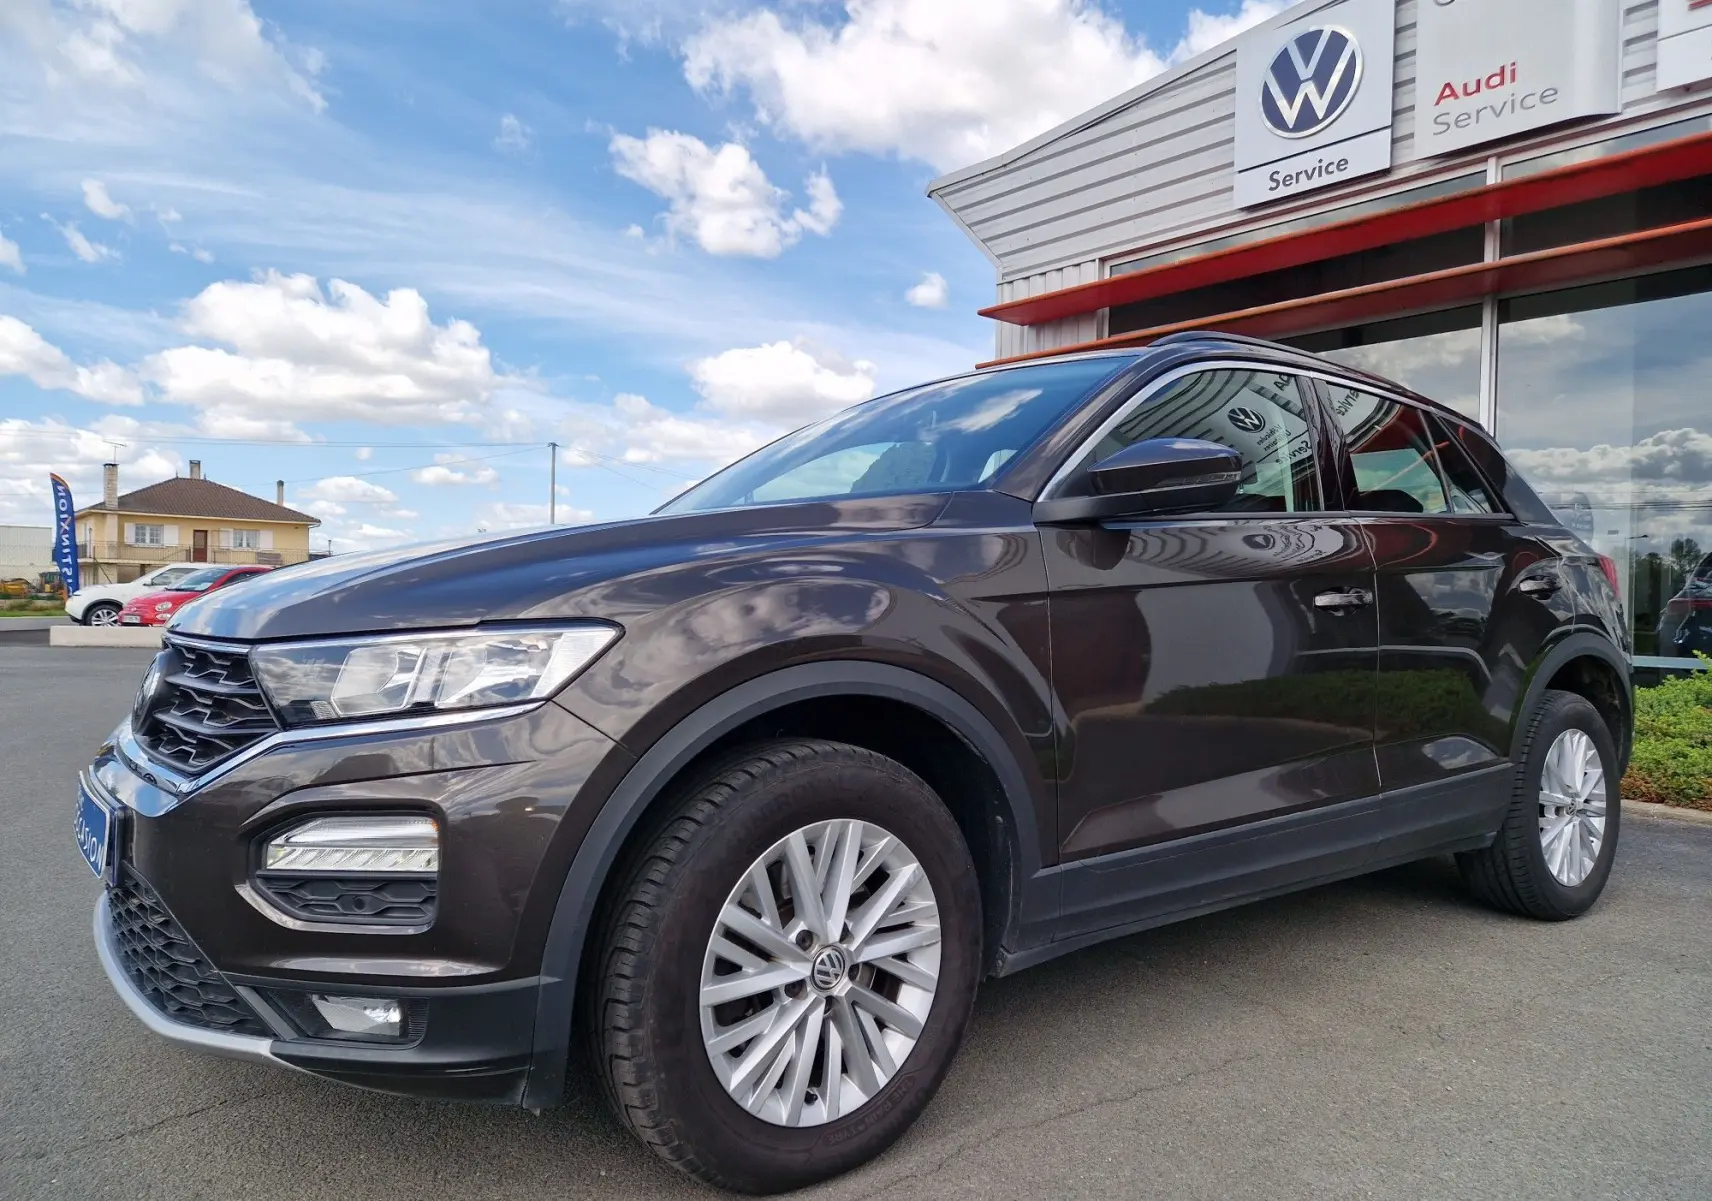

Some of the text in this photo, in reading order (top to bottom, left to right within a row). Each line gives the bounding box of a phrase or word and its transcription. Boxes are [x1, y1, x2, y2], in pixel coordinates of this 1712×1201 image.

[1433, 60, 1516, 106] Audi
[1432, 86, 1558, 136] Service
[1268, 157, 1349, 192] Service
